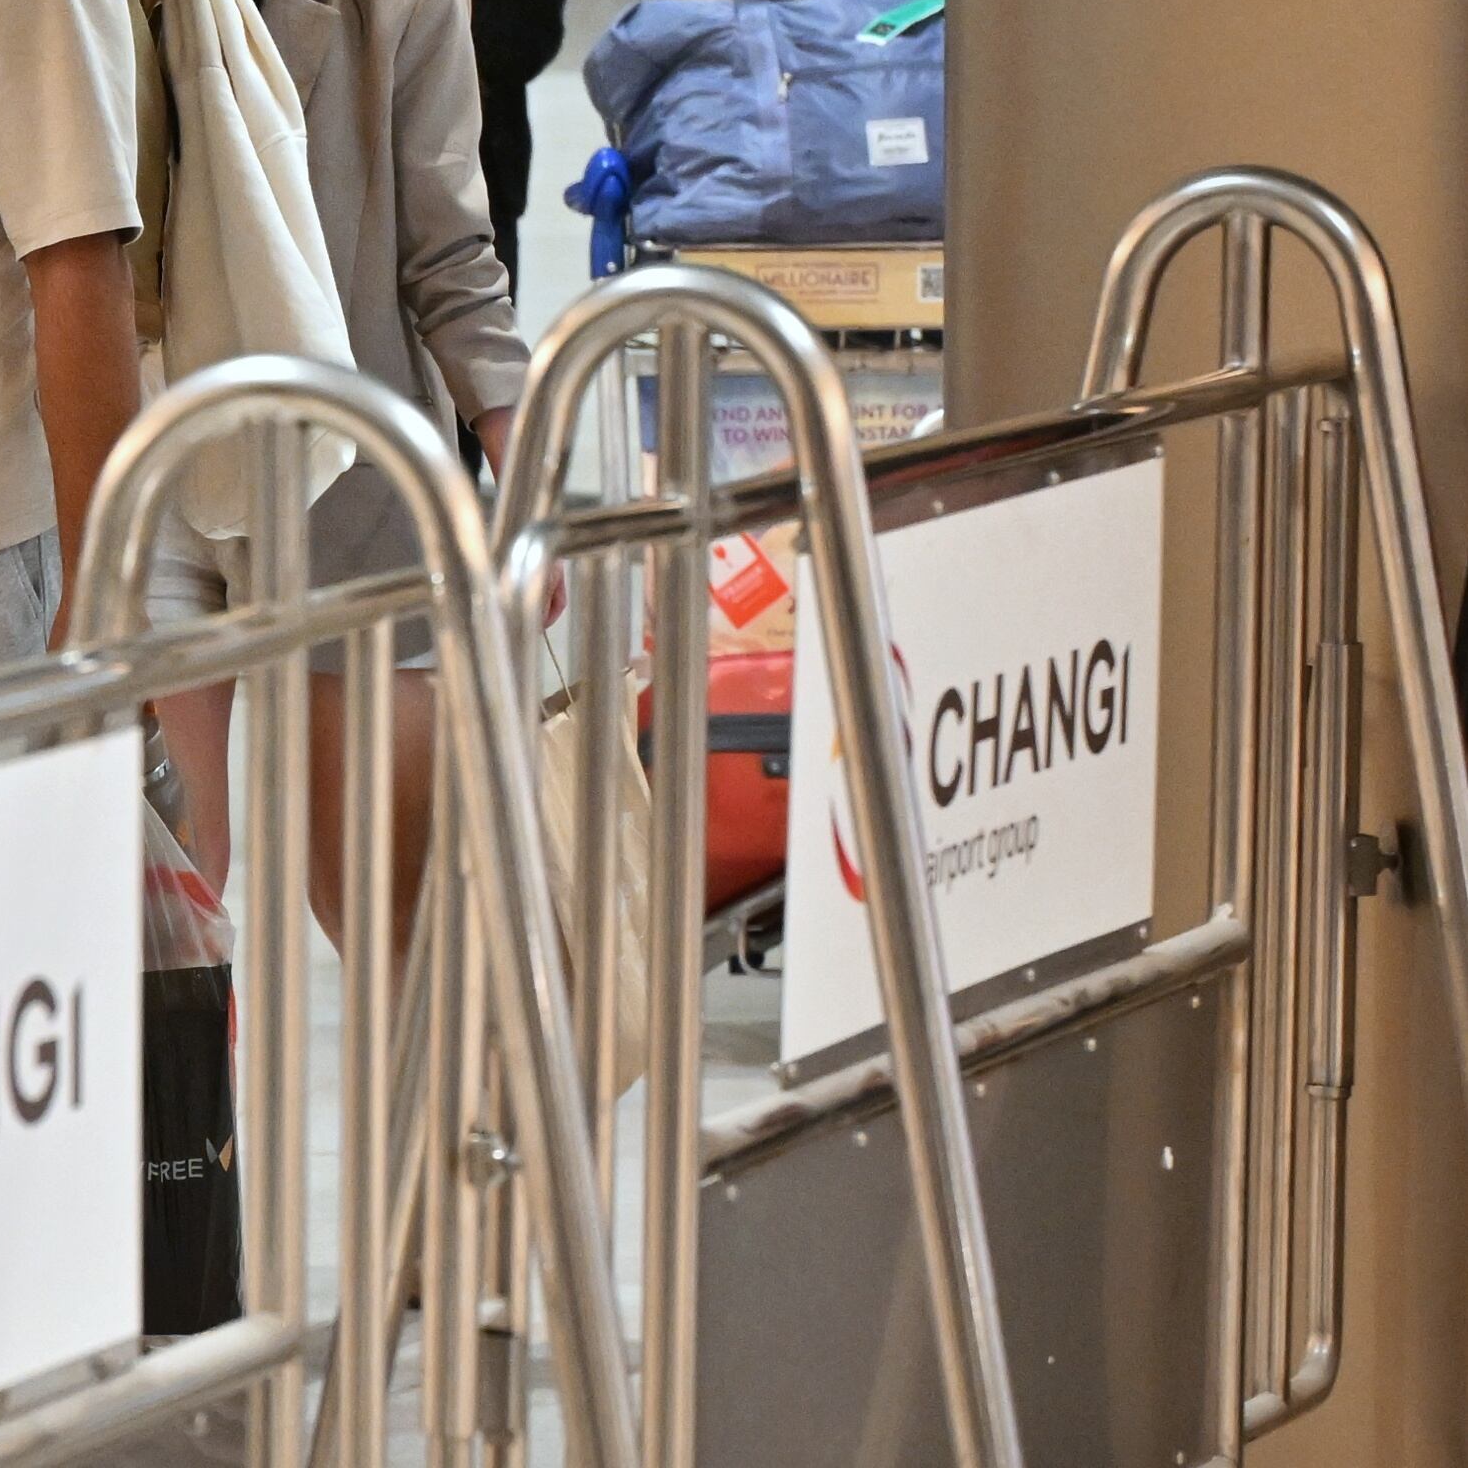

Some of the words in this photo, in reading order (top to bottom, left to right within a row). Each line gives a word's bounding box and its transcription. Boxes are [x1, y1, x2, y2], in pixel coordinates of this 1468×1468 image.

[723, 427, 748, 444] TO
[929, 639, 1131, 808] CHANGI
[926, 828, 985, 894] airport
[987, 813, 1040, 879] group
[147, 1157, 204, 1183] FREE
